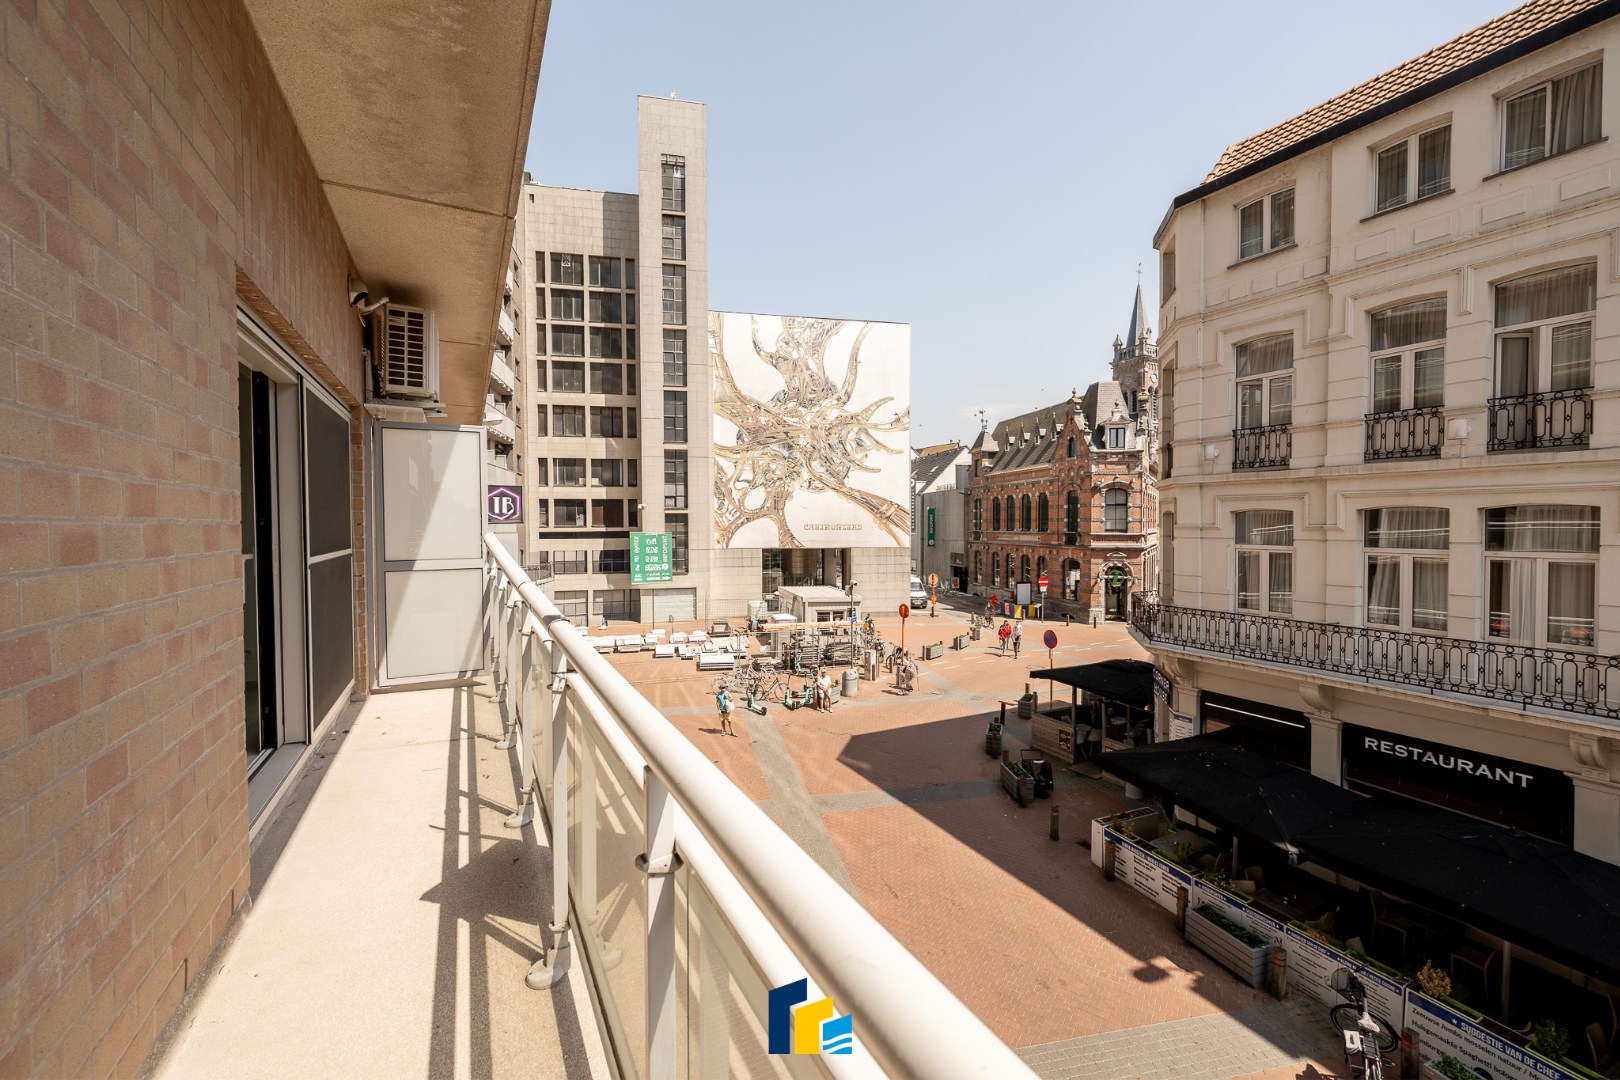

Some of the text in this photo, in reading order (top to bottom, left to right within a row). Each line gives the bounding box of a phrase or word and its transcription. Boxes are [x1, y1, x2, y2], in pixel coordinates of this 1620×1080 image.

[1364, 736, 1534, 788] RESTAURANT
[1411, 1019, 1458, 1049] Huisgemaakte
[1458, 1045, 1493, 1069] Spaghetti
[1412, 1007, 1440, 1026] Zeeuwse
[1441, 1023, 1463, 1039] Jumbo
[1463, 1036, 1496, 1058] mosselen
[1497, 1054, 1522, 1072] natuur
[1461, 1022, 1561, 1080] SUGGESTIE VAN DE CHEF
